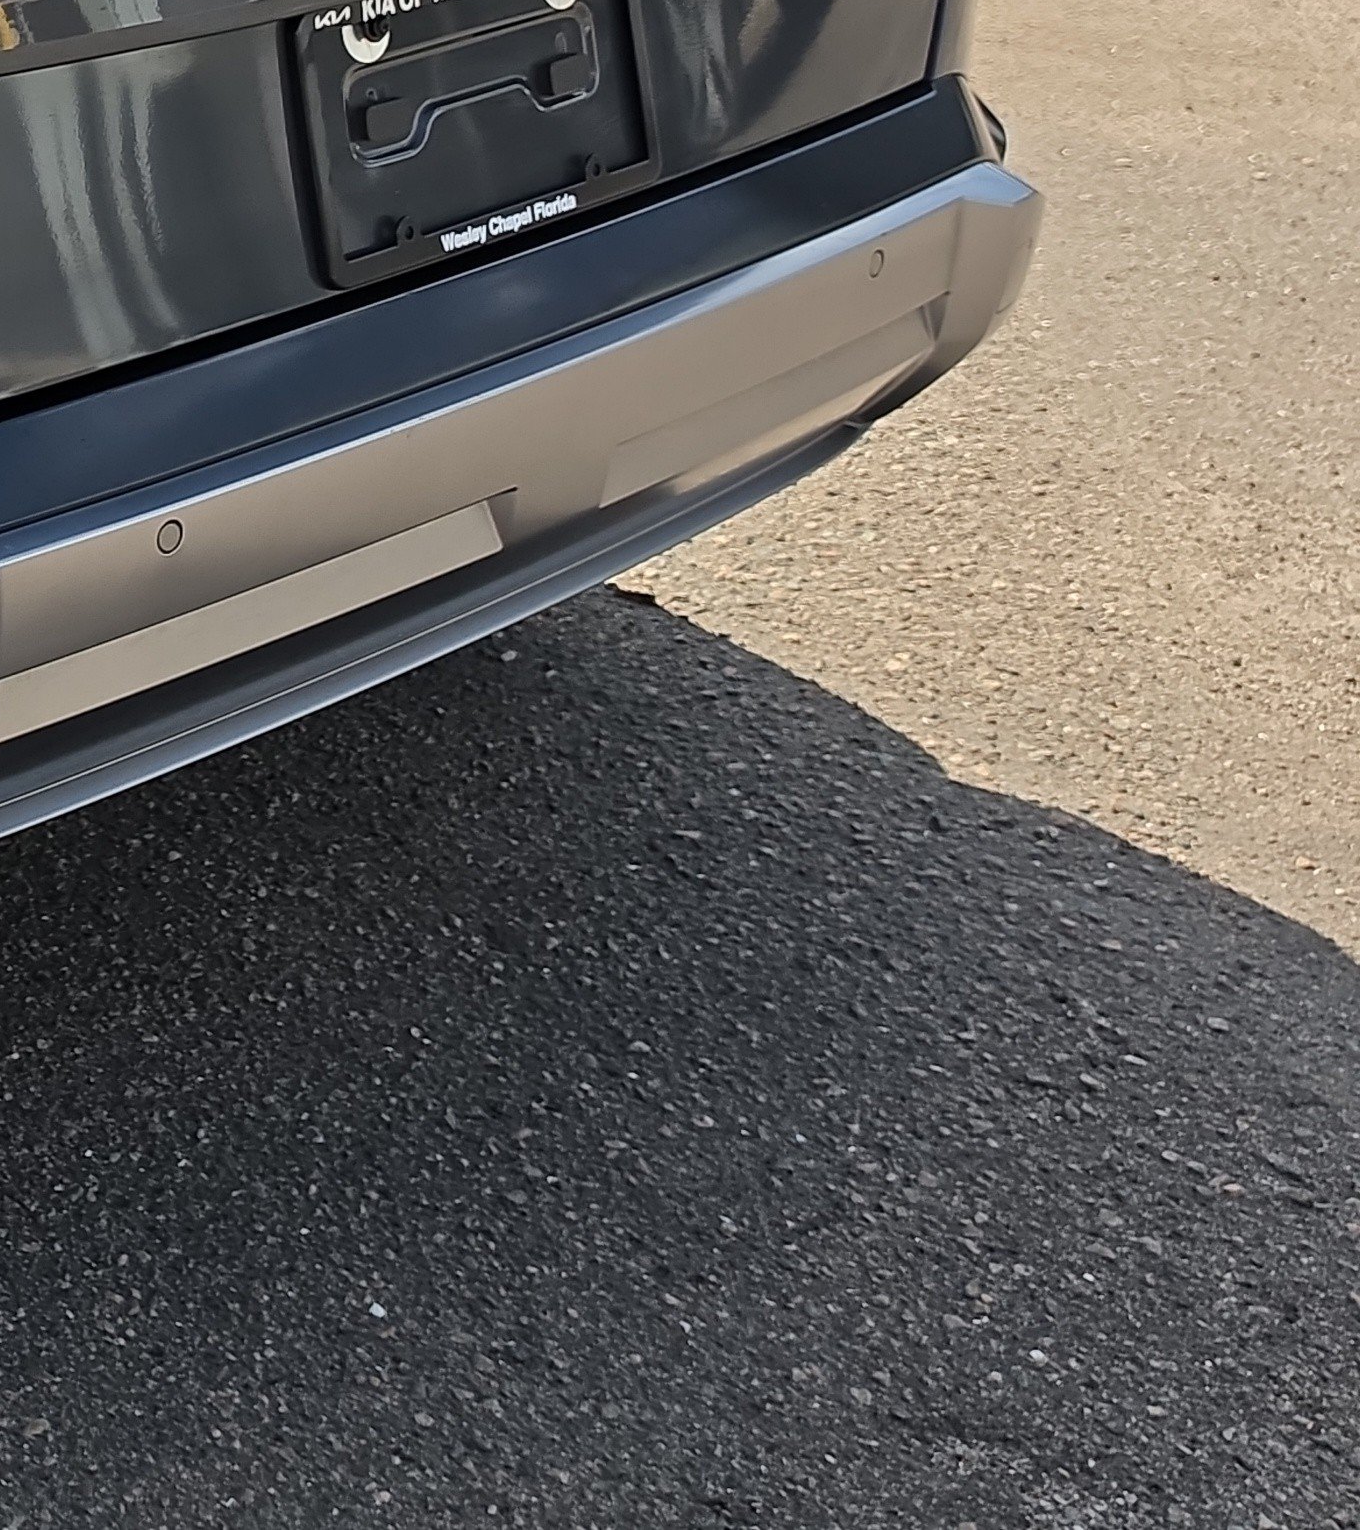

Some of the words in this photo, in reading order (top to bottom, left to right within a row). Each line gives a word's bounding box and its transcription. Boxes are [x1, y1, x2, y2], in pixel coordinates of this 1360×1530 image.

[440, 224, 487, 252] Wesley
[488, 205, 533, 236] Chapel
[533, 193, 577, 222] Florida
